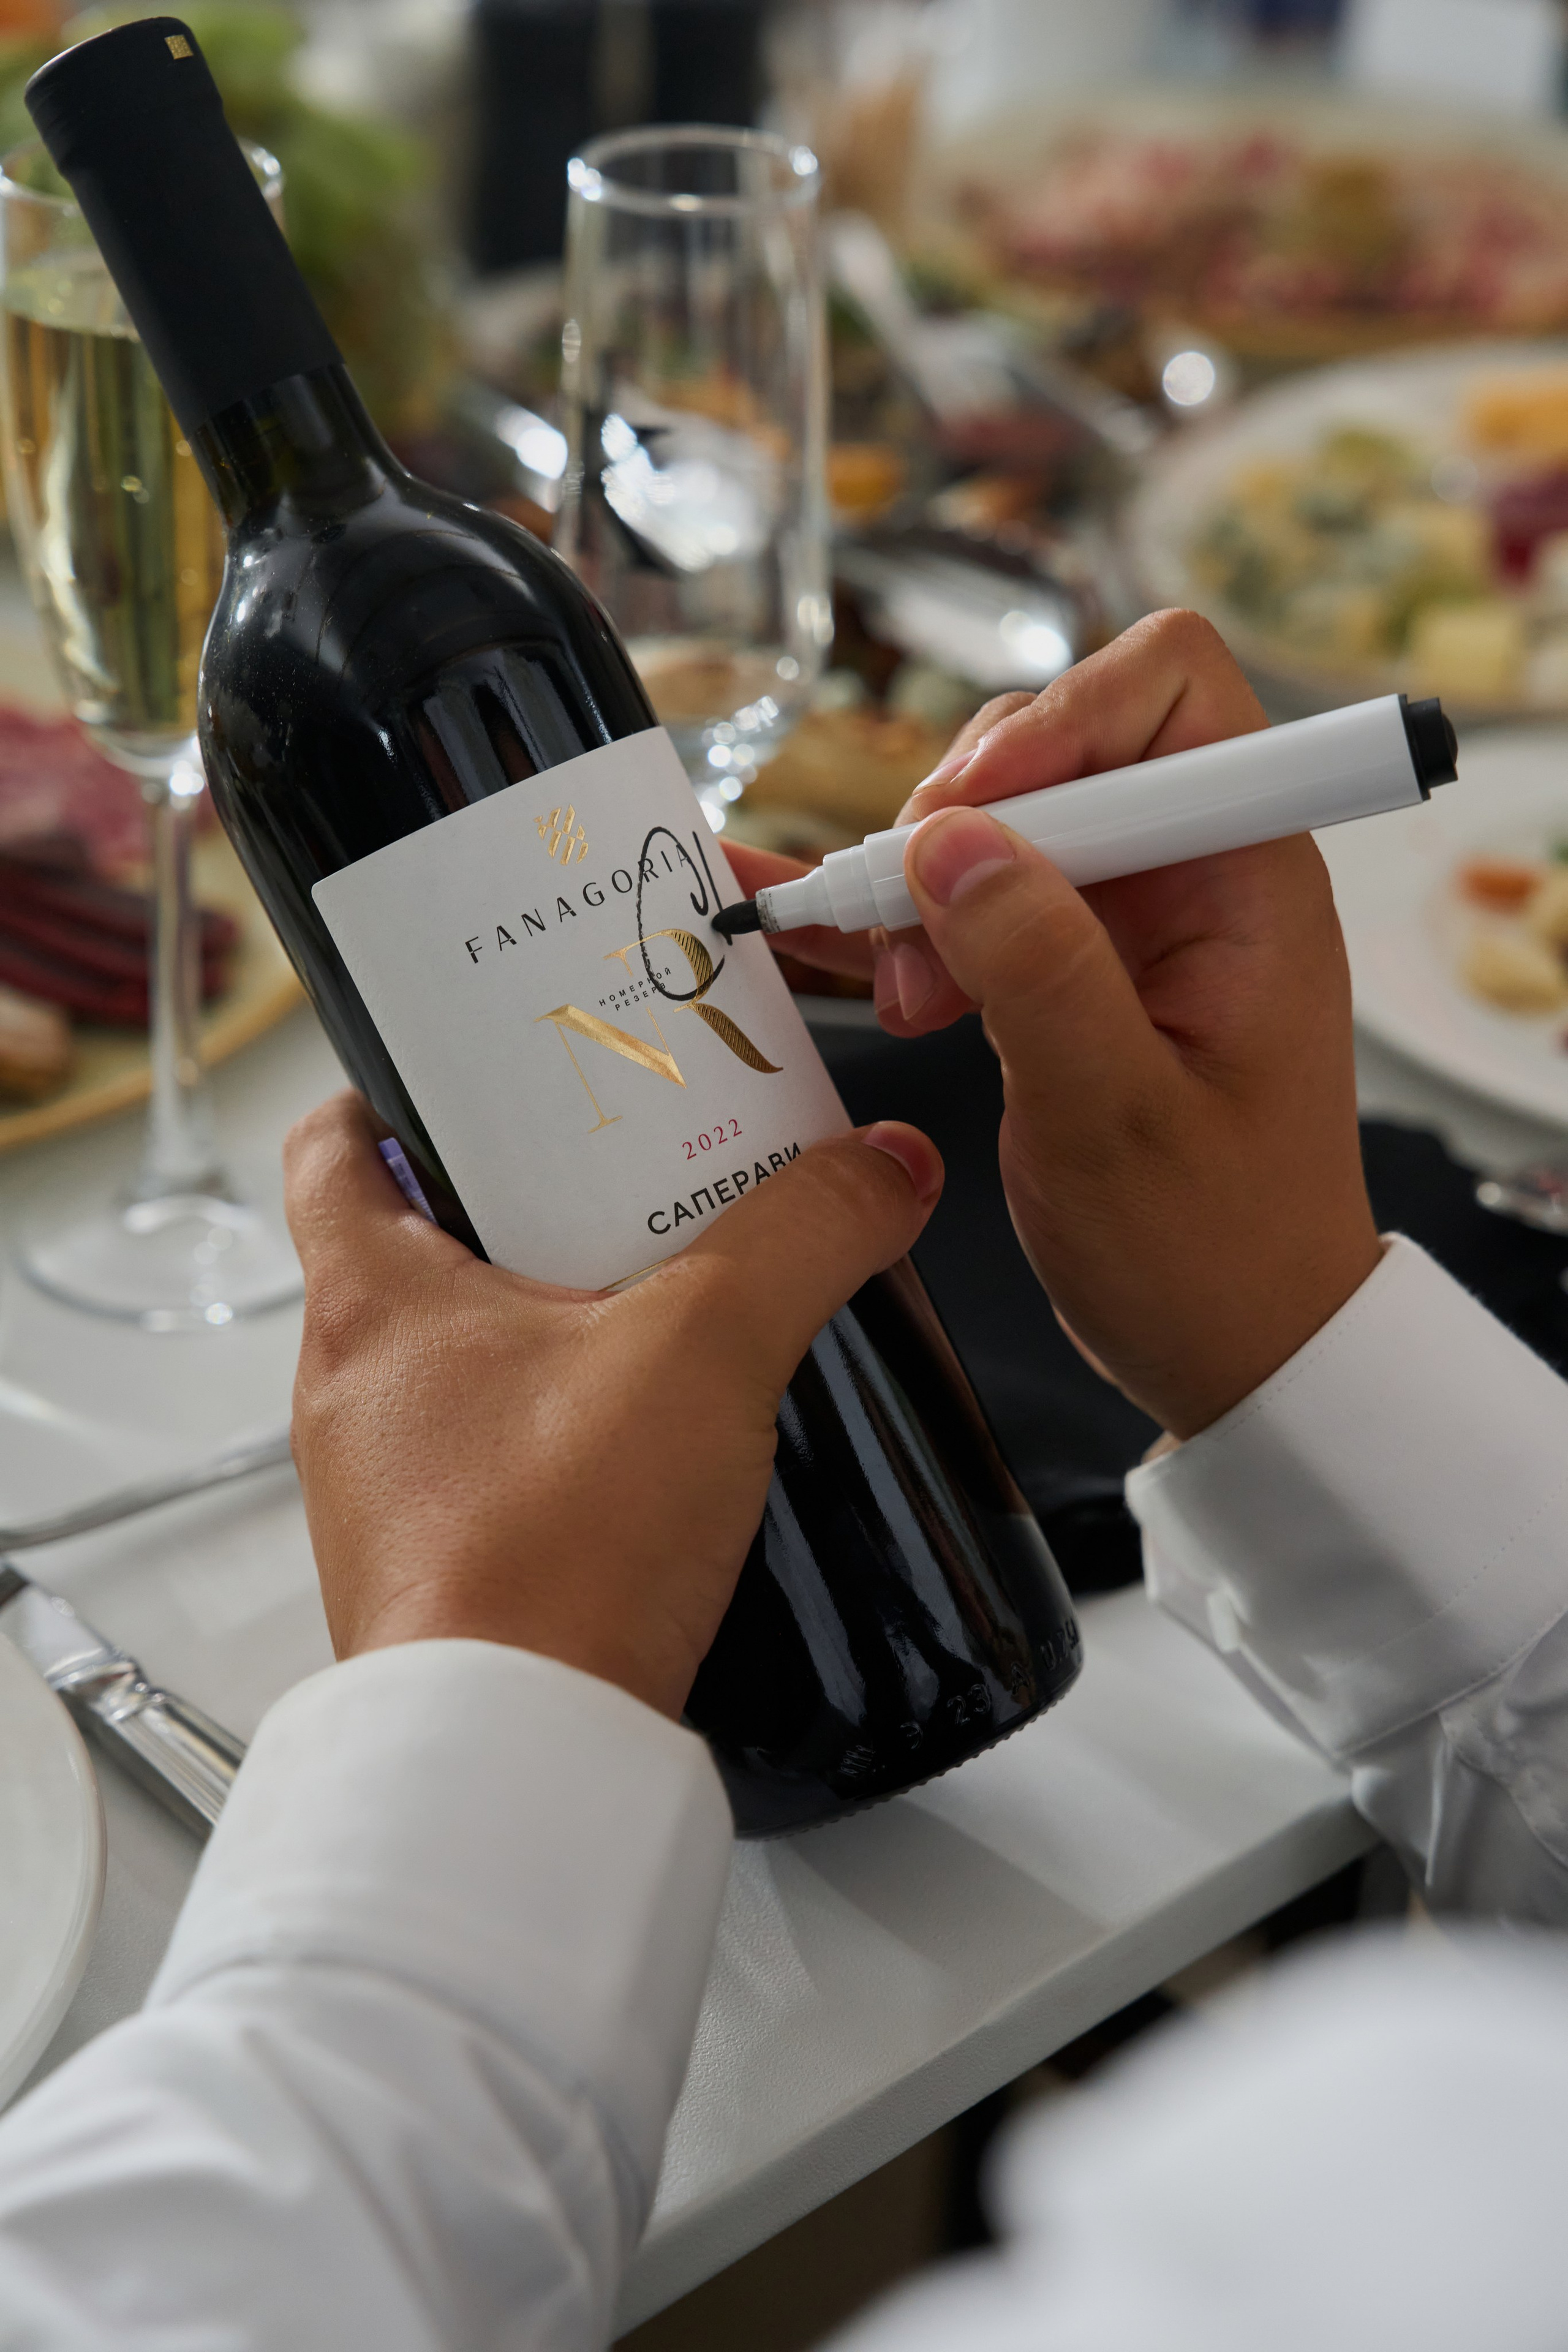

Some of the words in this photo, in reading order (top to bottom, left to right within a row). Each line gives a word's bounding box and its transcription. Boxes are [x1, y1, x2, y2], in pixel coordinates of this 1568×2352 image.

[465, 843, 691, 964] FANAGORIA
[615, 982, 666, 1011] РЕЗЕРВ
[682, 1118, 742, 1160] 2022
[647, 1142, 801, 1235] САПЕРАВИ
